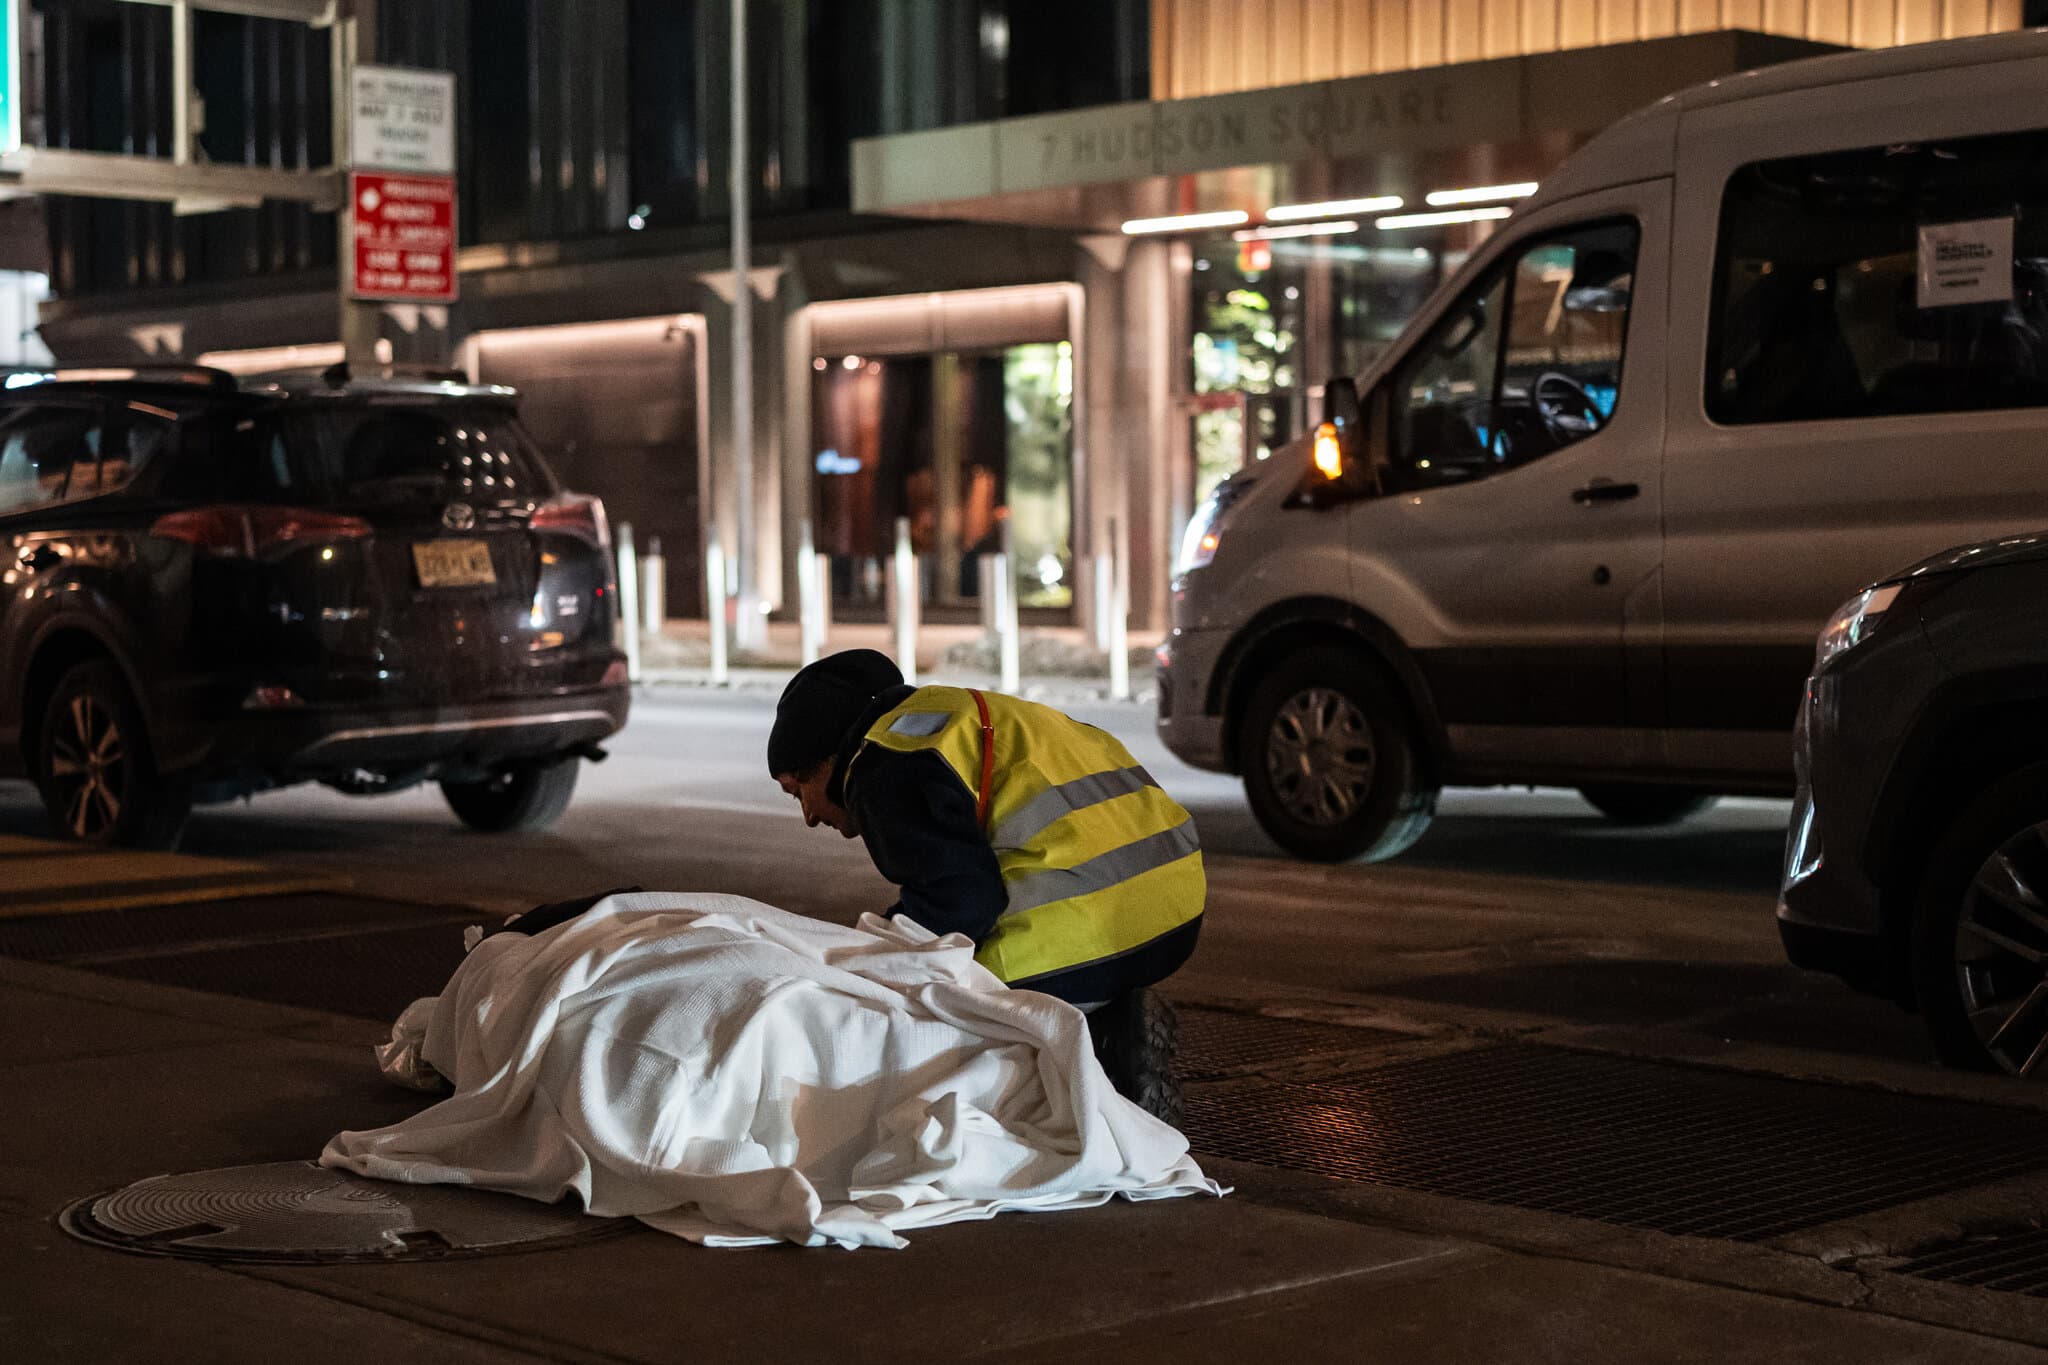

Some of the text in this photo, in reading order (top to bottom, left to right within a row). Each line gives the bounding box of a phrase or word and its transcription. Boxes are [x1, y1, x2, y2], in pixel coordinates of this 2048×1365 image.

[1040, 84, 1454, 166] 7 HUDSON SQUARE
